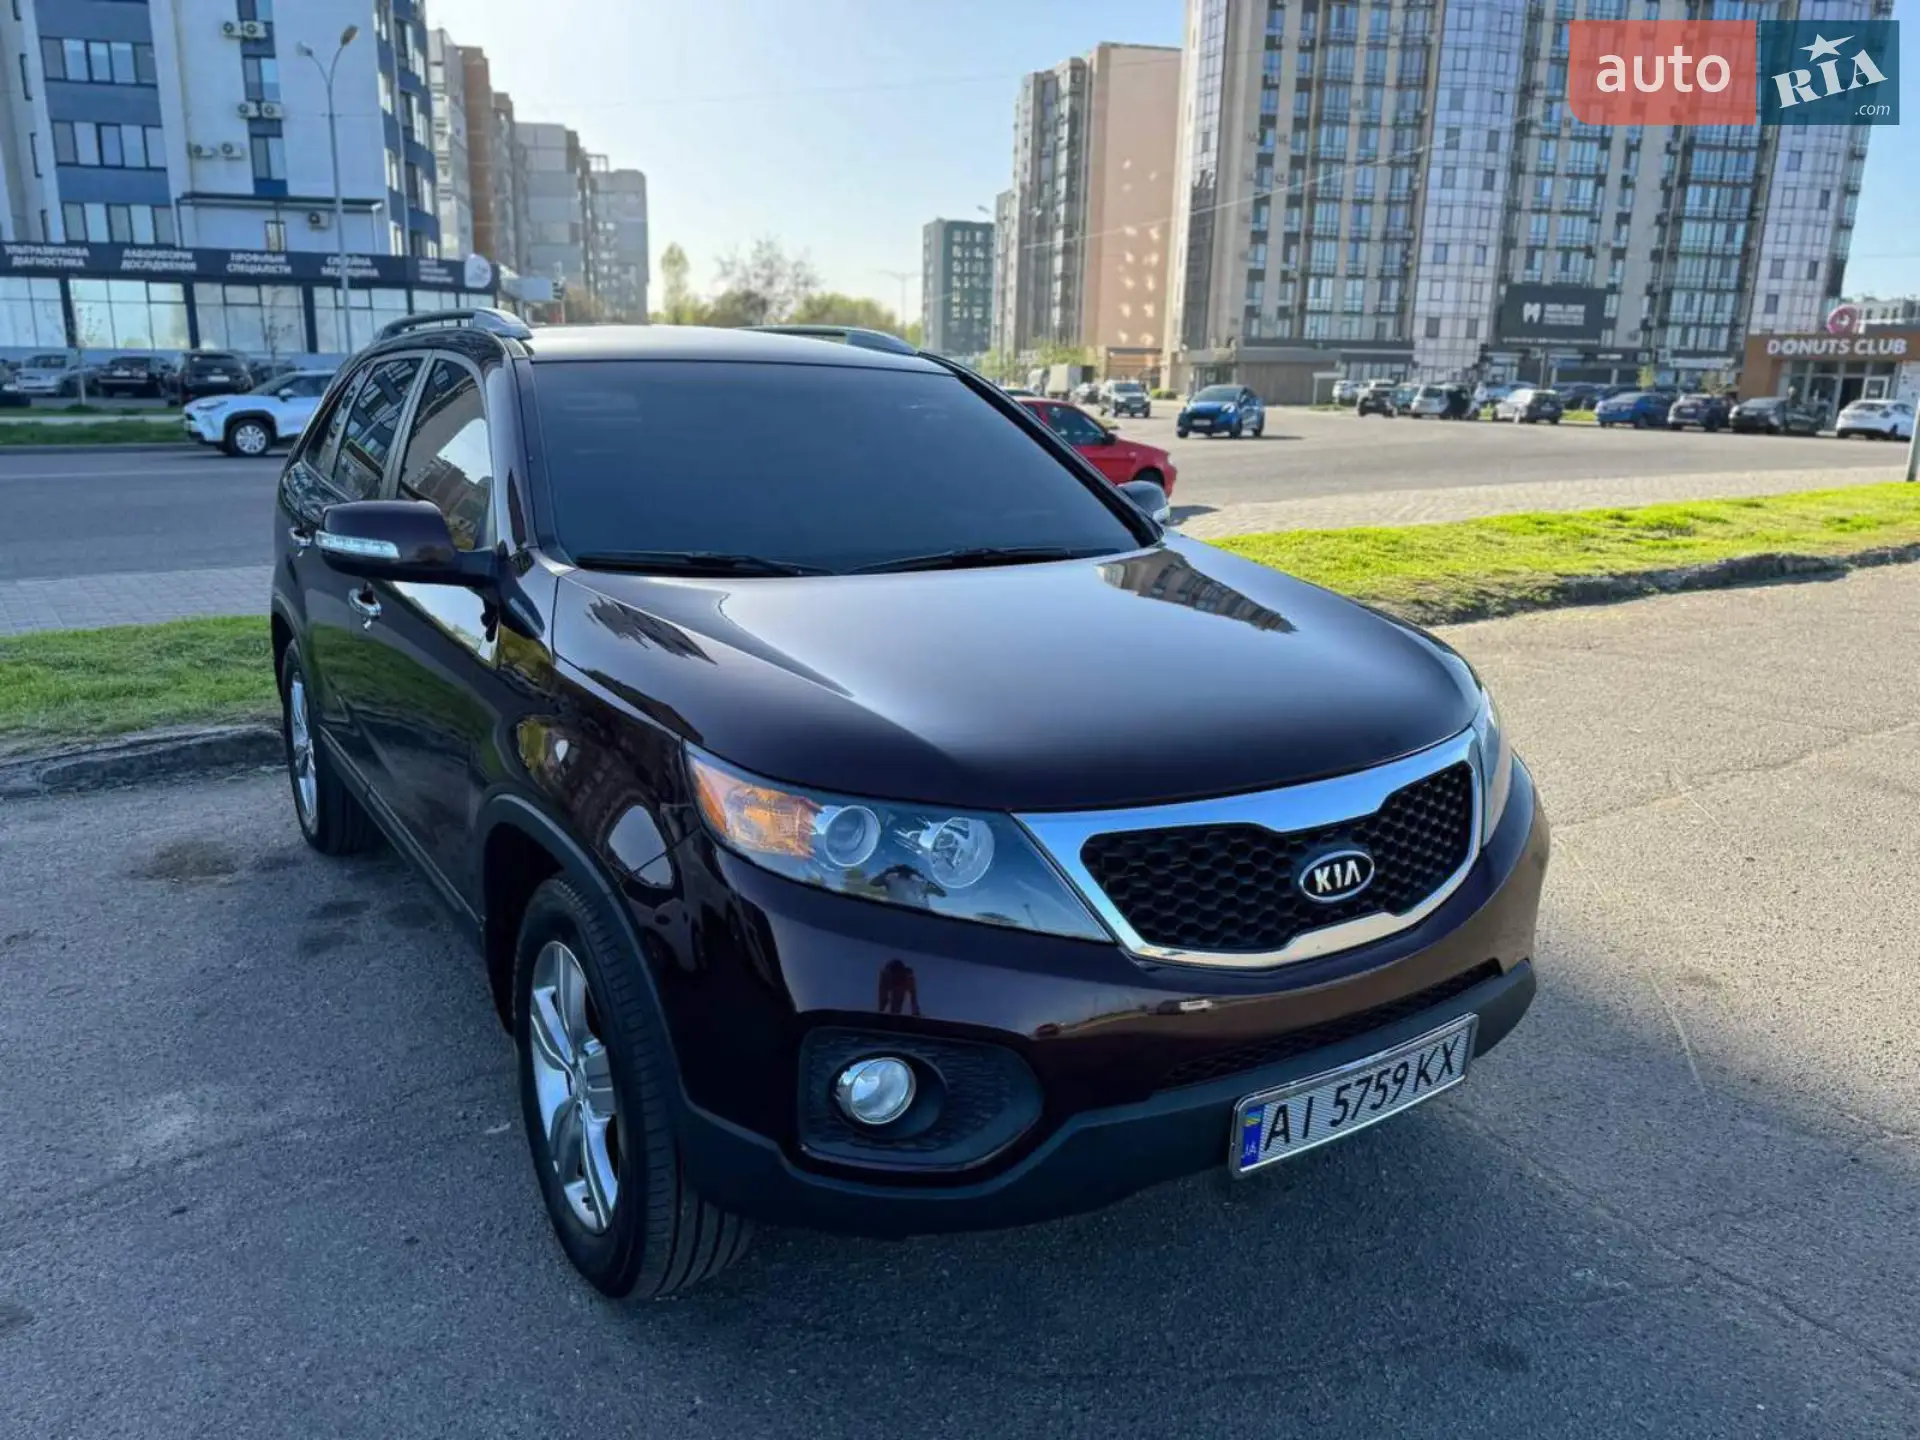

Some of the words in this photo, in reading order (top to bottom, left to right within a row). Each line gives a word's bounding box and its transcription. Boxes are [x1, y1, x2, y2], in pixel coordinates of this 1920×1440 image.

[1767, 338, 1850, 355] DONUTS
[1853, 337, 1908, 355] CLUB
[1313, 859, 1361, 893] KIA
